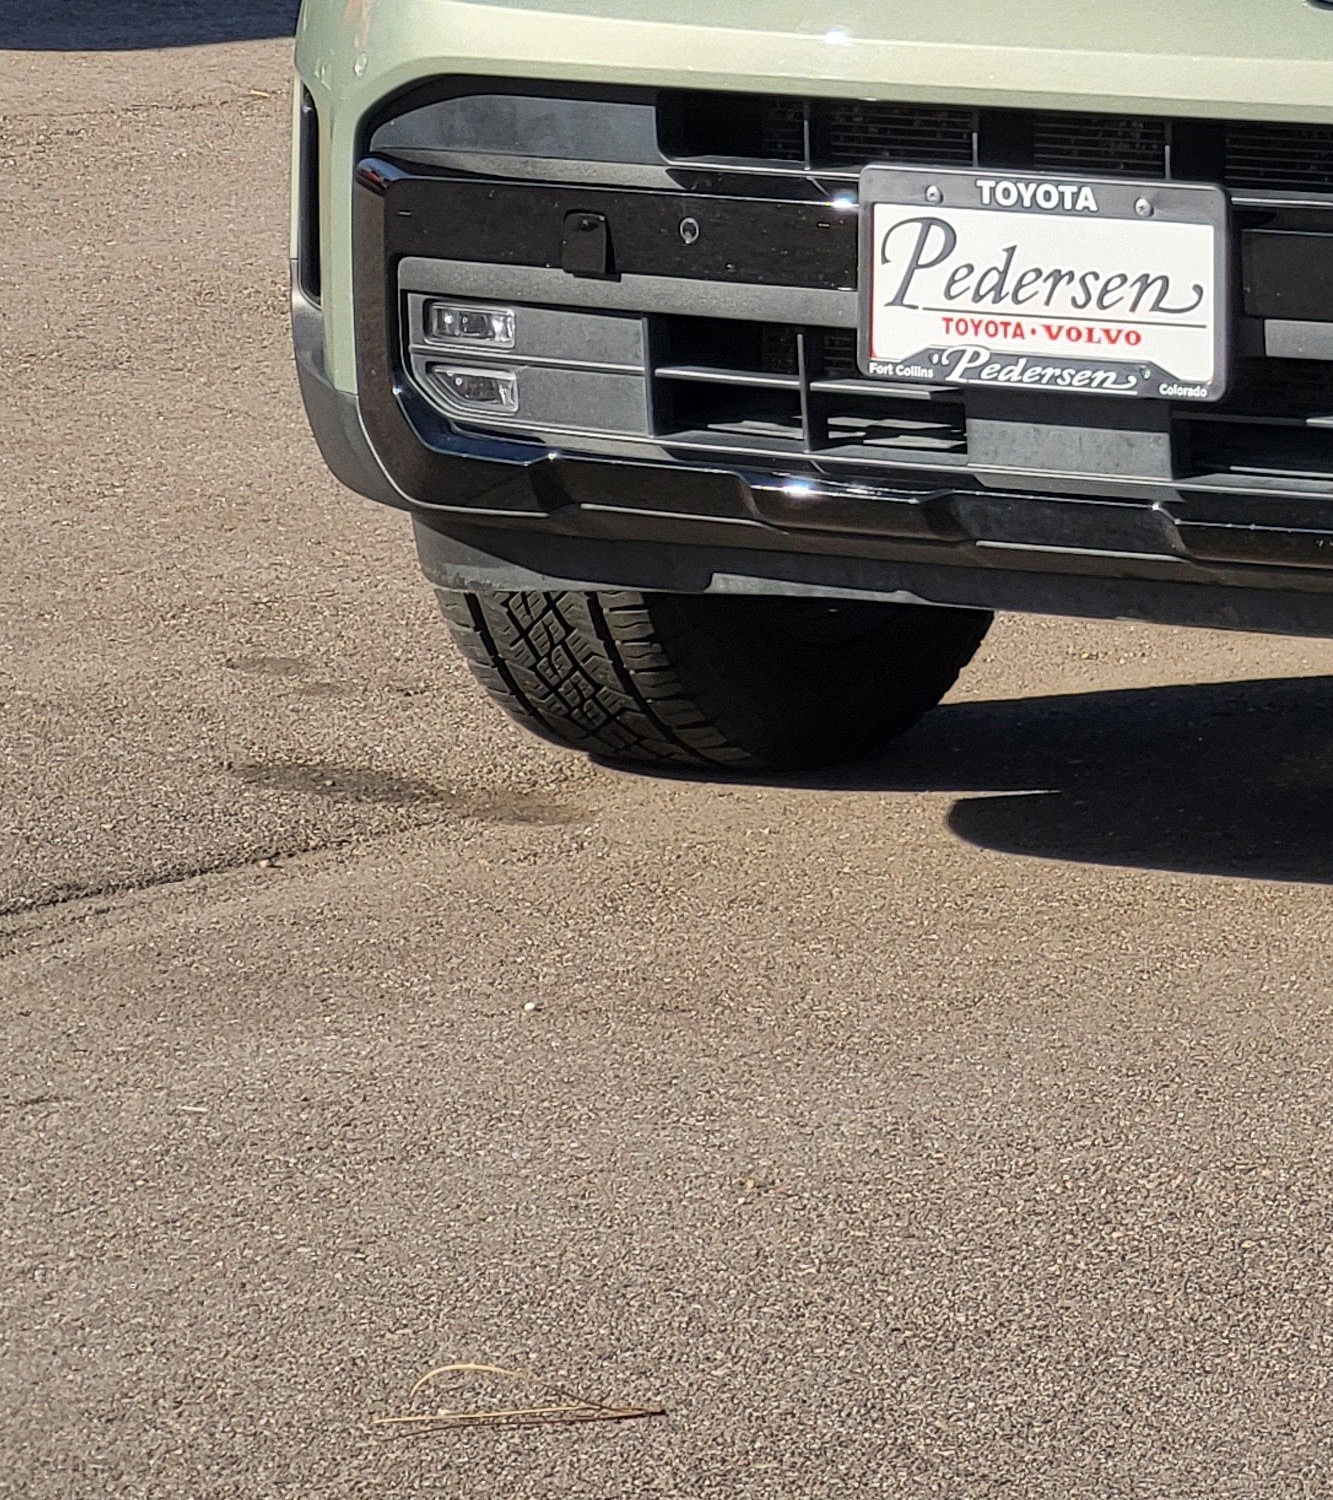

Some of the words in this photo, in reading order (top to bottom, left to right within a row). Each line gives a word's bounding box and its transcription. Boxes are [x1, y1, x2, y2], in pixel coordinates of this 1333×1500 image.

[975, 179, 1099, 213] TOYOTA
[880, 216, 1204, 315] Pedersen
[941, 316, 1026, 340] TOYOTA
[1041, 324, 1142, 346] VOLVO
[868, 362, 894, 377] Fort
[895, 363, 934, 379] Collins
[940, 345, 1138, 392] Pedersen
[1159, 383, 1208, 399] Colorado
